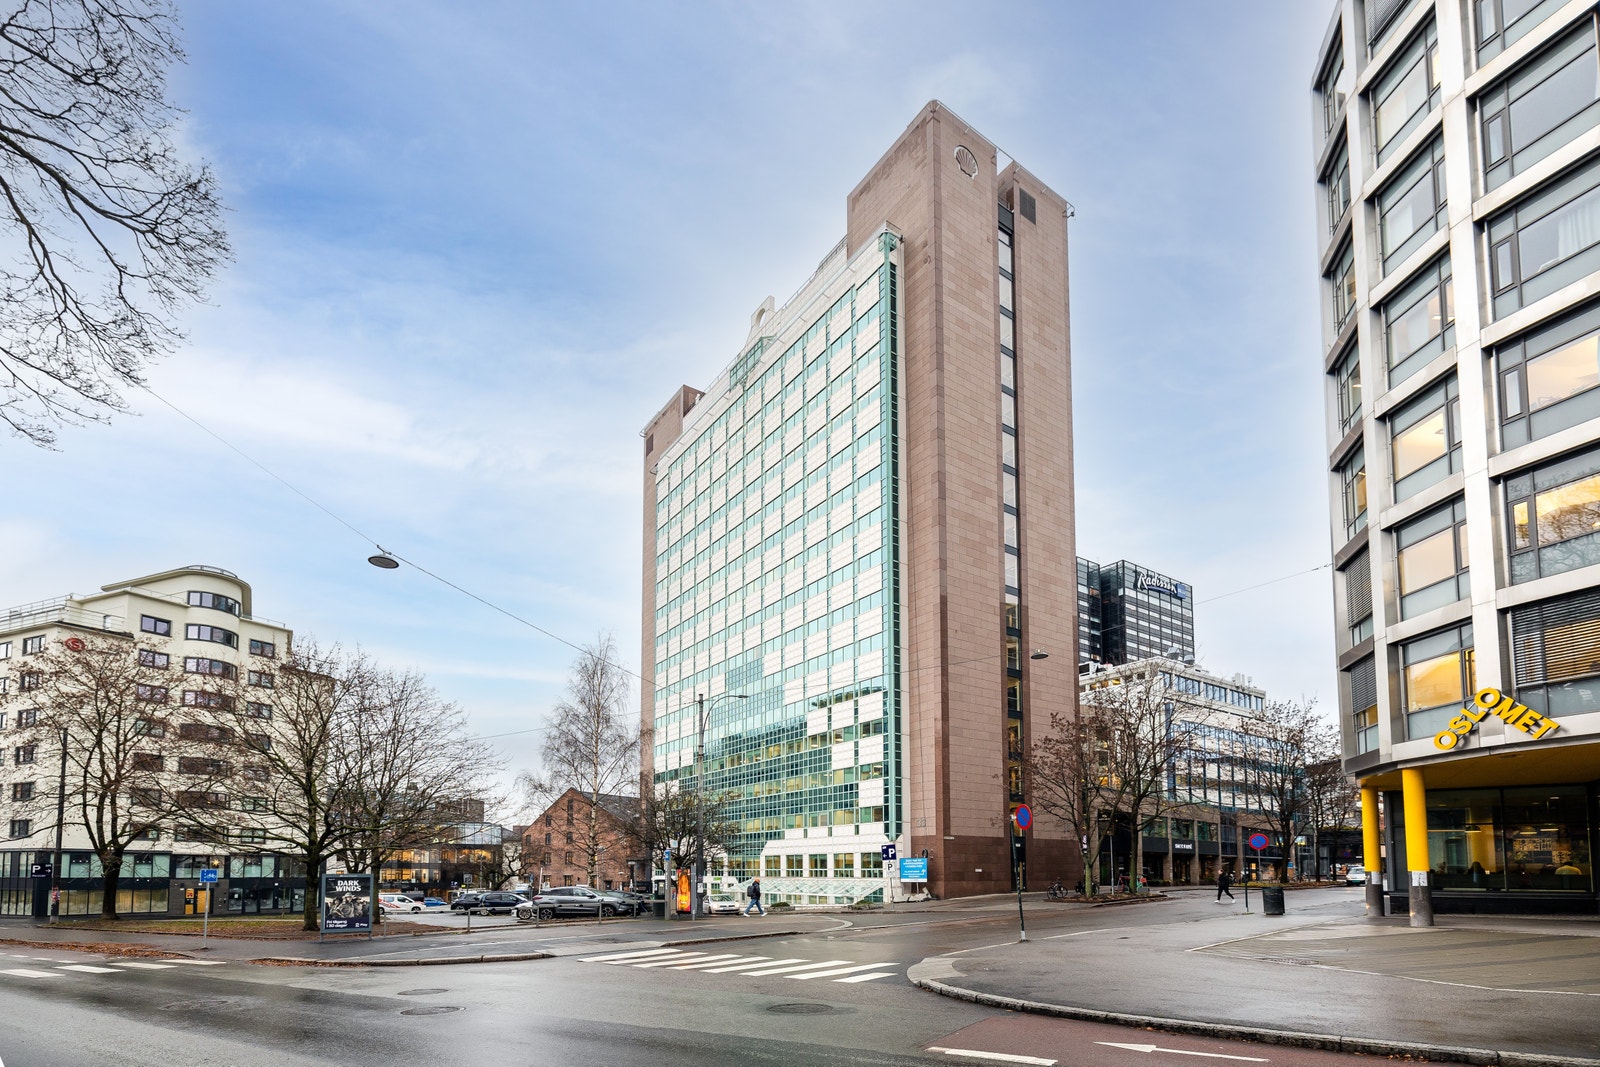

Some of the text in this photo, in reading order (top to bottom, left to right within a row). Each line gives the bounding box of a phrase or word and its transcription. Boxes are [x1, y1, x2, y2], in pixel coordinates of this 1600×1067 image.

[1137, 570, 1178, 594] Radisson
[1433, 688, 1560, 751] OSLOMET
[888, 848, 896, 858] P
[32, 865, 41, 873] P
[887, 863, 893, 871] P
